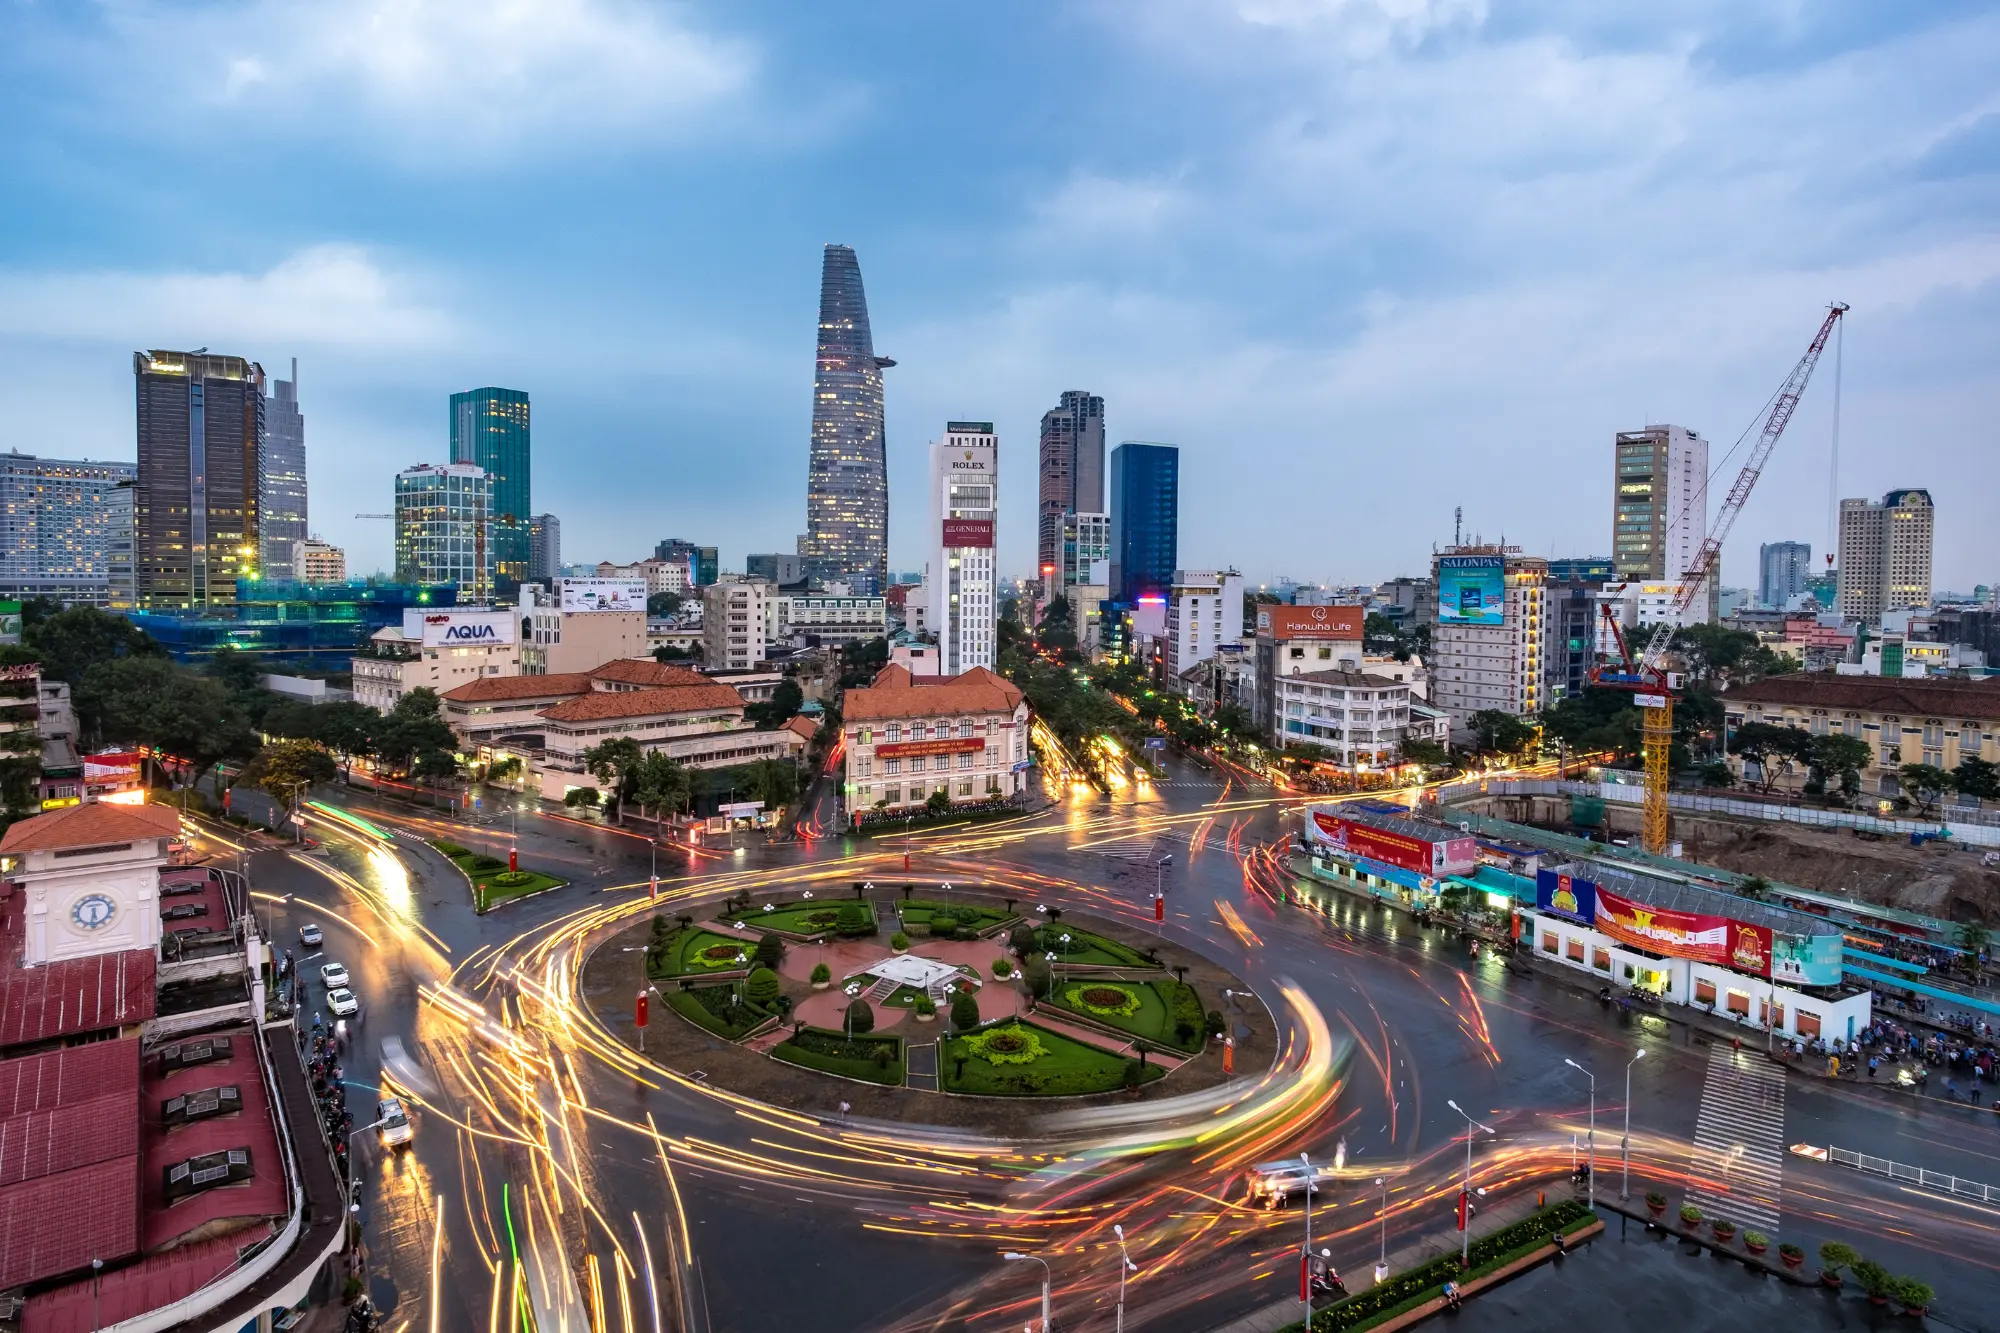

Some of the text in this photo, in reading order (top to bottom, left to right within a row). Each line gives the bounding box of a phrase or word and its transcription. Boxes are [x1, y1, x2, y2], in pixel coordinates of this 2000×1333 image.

[952, 462, 985, 470] ROLEX
[1499, 545, 1523, 554] HOTEL
[1443, 558, 1501, 568] SALONPAS
[1286, 622, 1352, 631] Hanwha Life
[446, 624, 495, 640] AQUA
